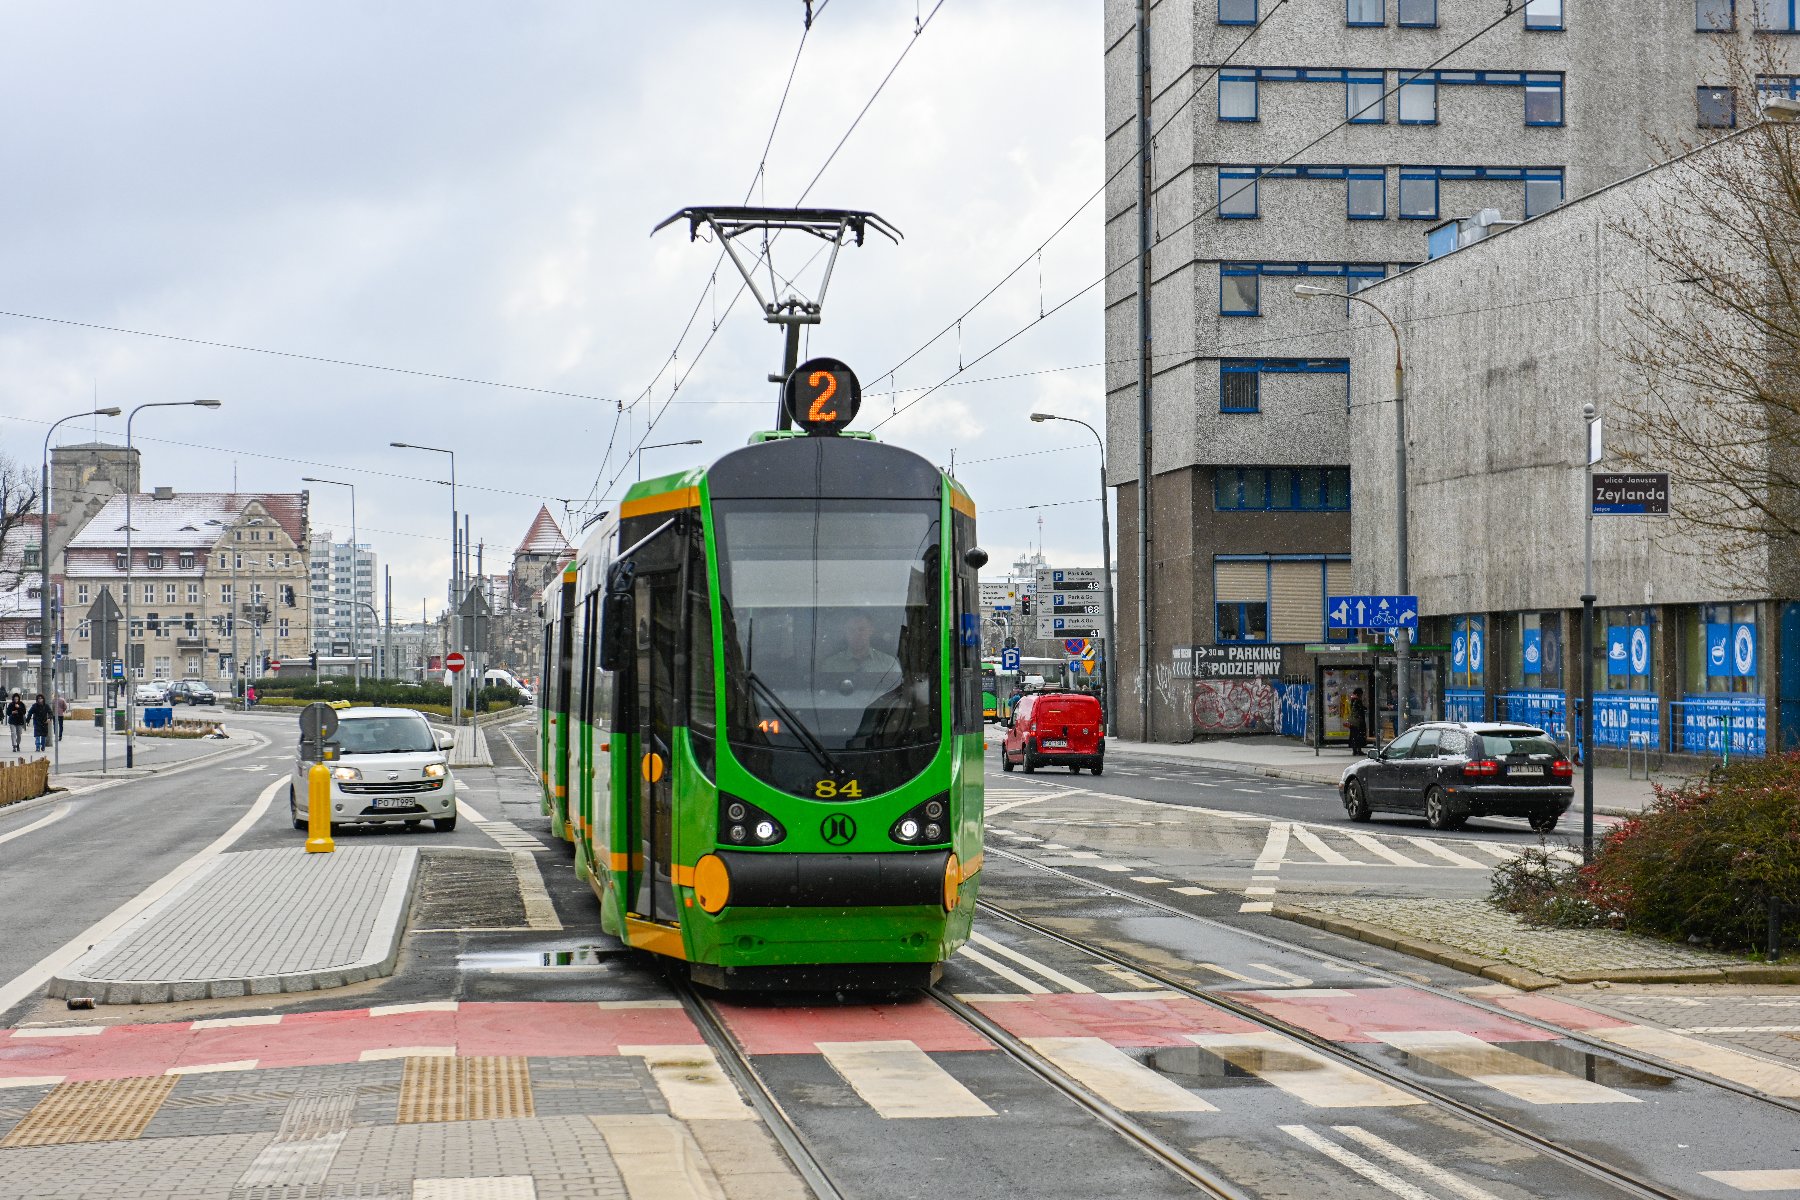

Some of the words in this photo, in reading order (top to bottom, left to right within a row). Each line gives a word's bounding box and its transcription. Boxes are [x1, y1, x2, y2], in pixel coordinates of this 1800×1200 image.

[807, 370, 838, 421] 2
[1605, 476, 1623, 484] ulica
[1596, 487, 1665, 504] Zeylanda
[1208, 648, 1217, 657] 30
[1228, 647, 1281, 660] PARKING
[1211, 661, 1281, 675] PODZIEMNY
[757, 719, 780, 734] 11
[814, 779, 863, 799] 84
